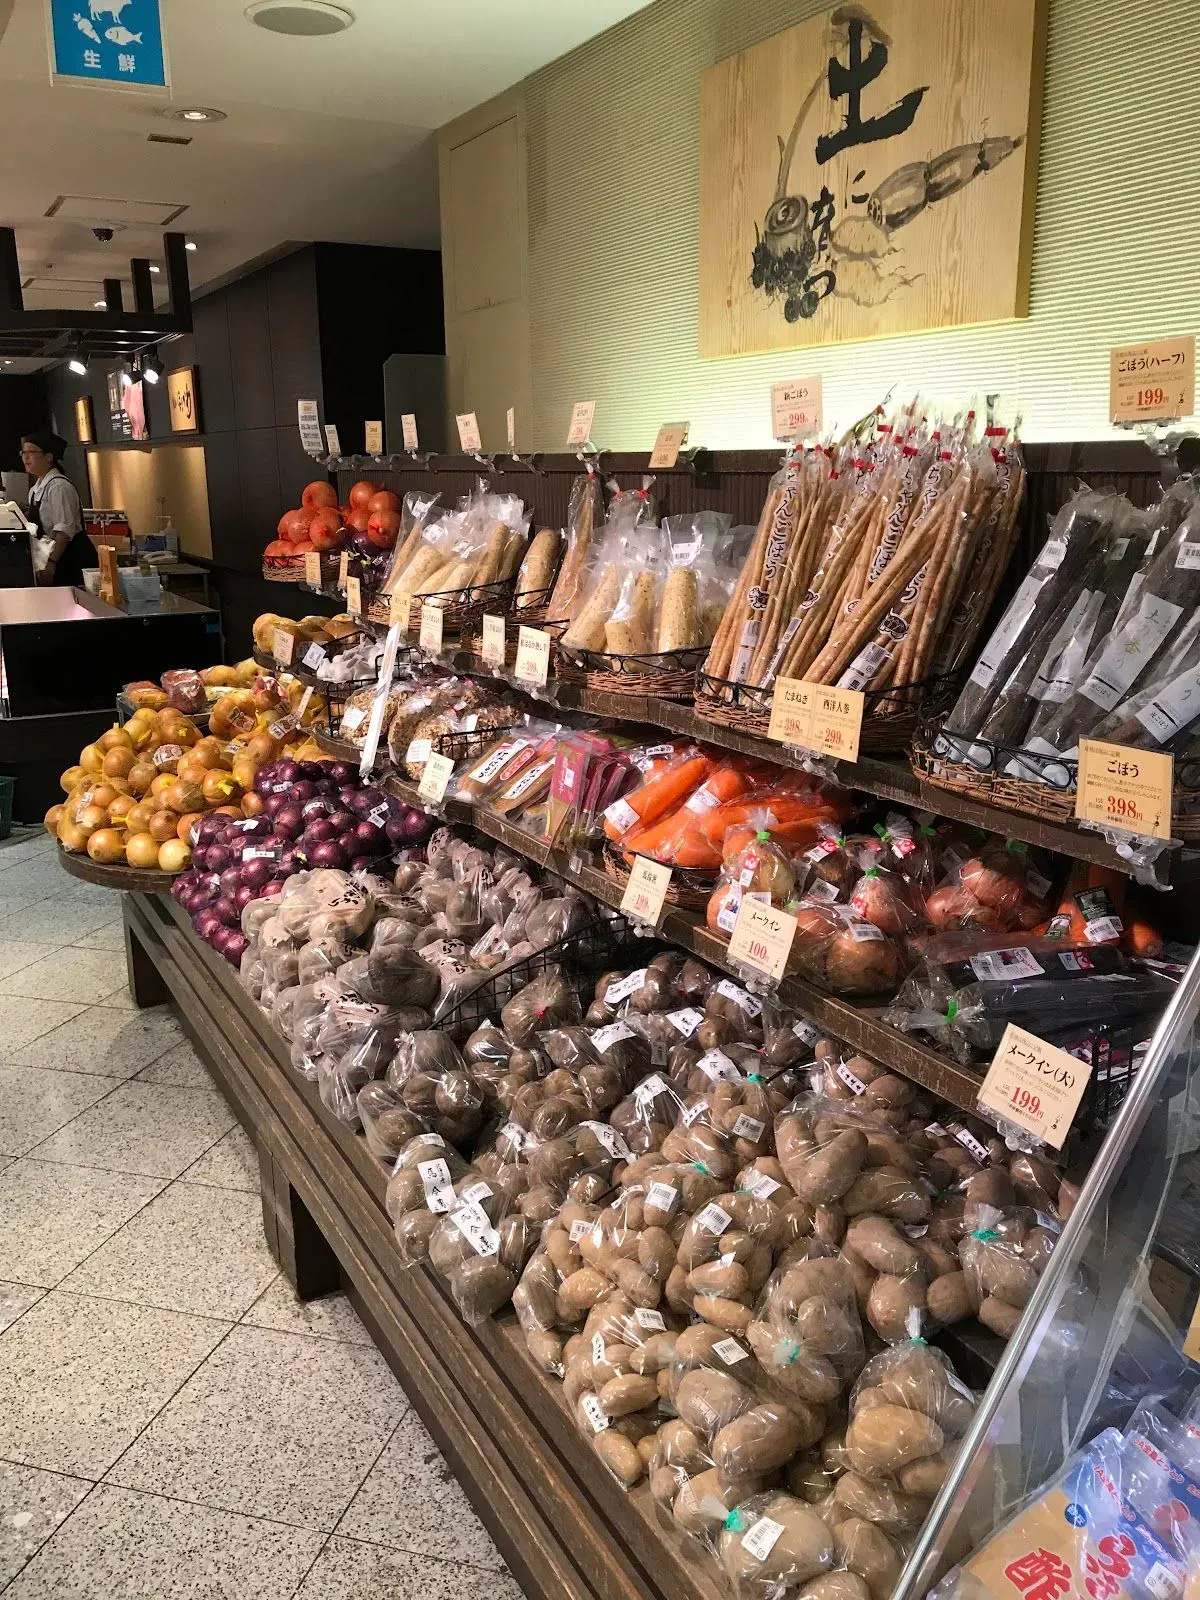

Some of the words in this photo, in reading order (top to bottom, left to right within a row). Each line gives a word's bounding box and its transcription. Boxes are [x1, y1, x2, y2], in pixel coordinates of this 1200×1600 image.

[83, 49, 136, 73] 生鮮
[1118, 352, 1185, 372] ごぼう(ハーフ)
[784, 690, 809, 705] たまねぎ
[823, 698, 850, 715] 西洋人参
[1107, 760, 1139, 778] ごぼう
[1107, 795, 1143, 820] 398円
[750, 912, 782, 932] メークイン
[1007, 1044, 1075, 1089] メークイン(大)
[1010, 1086, 1044, 1119] 199円
